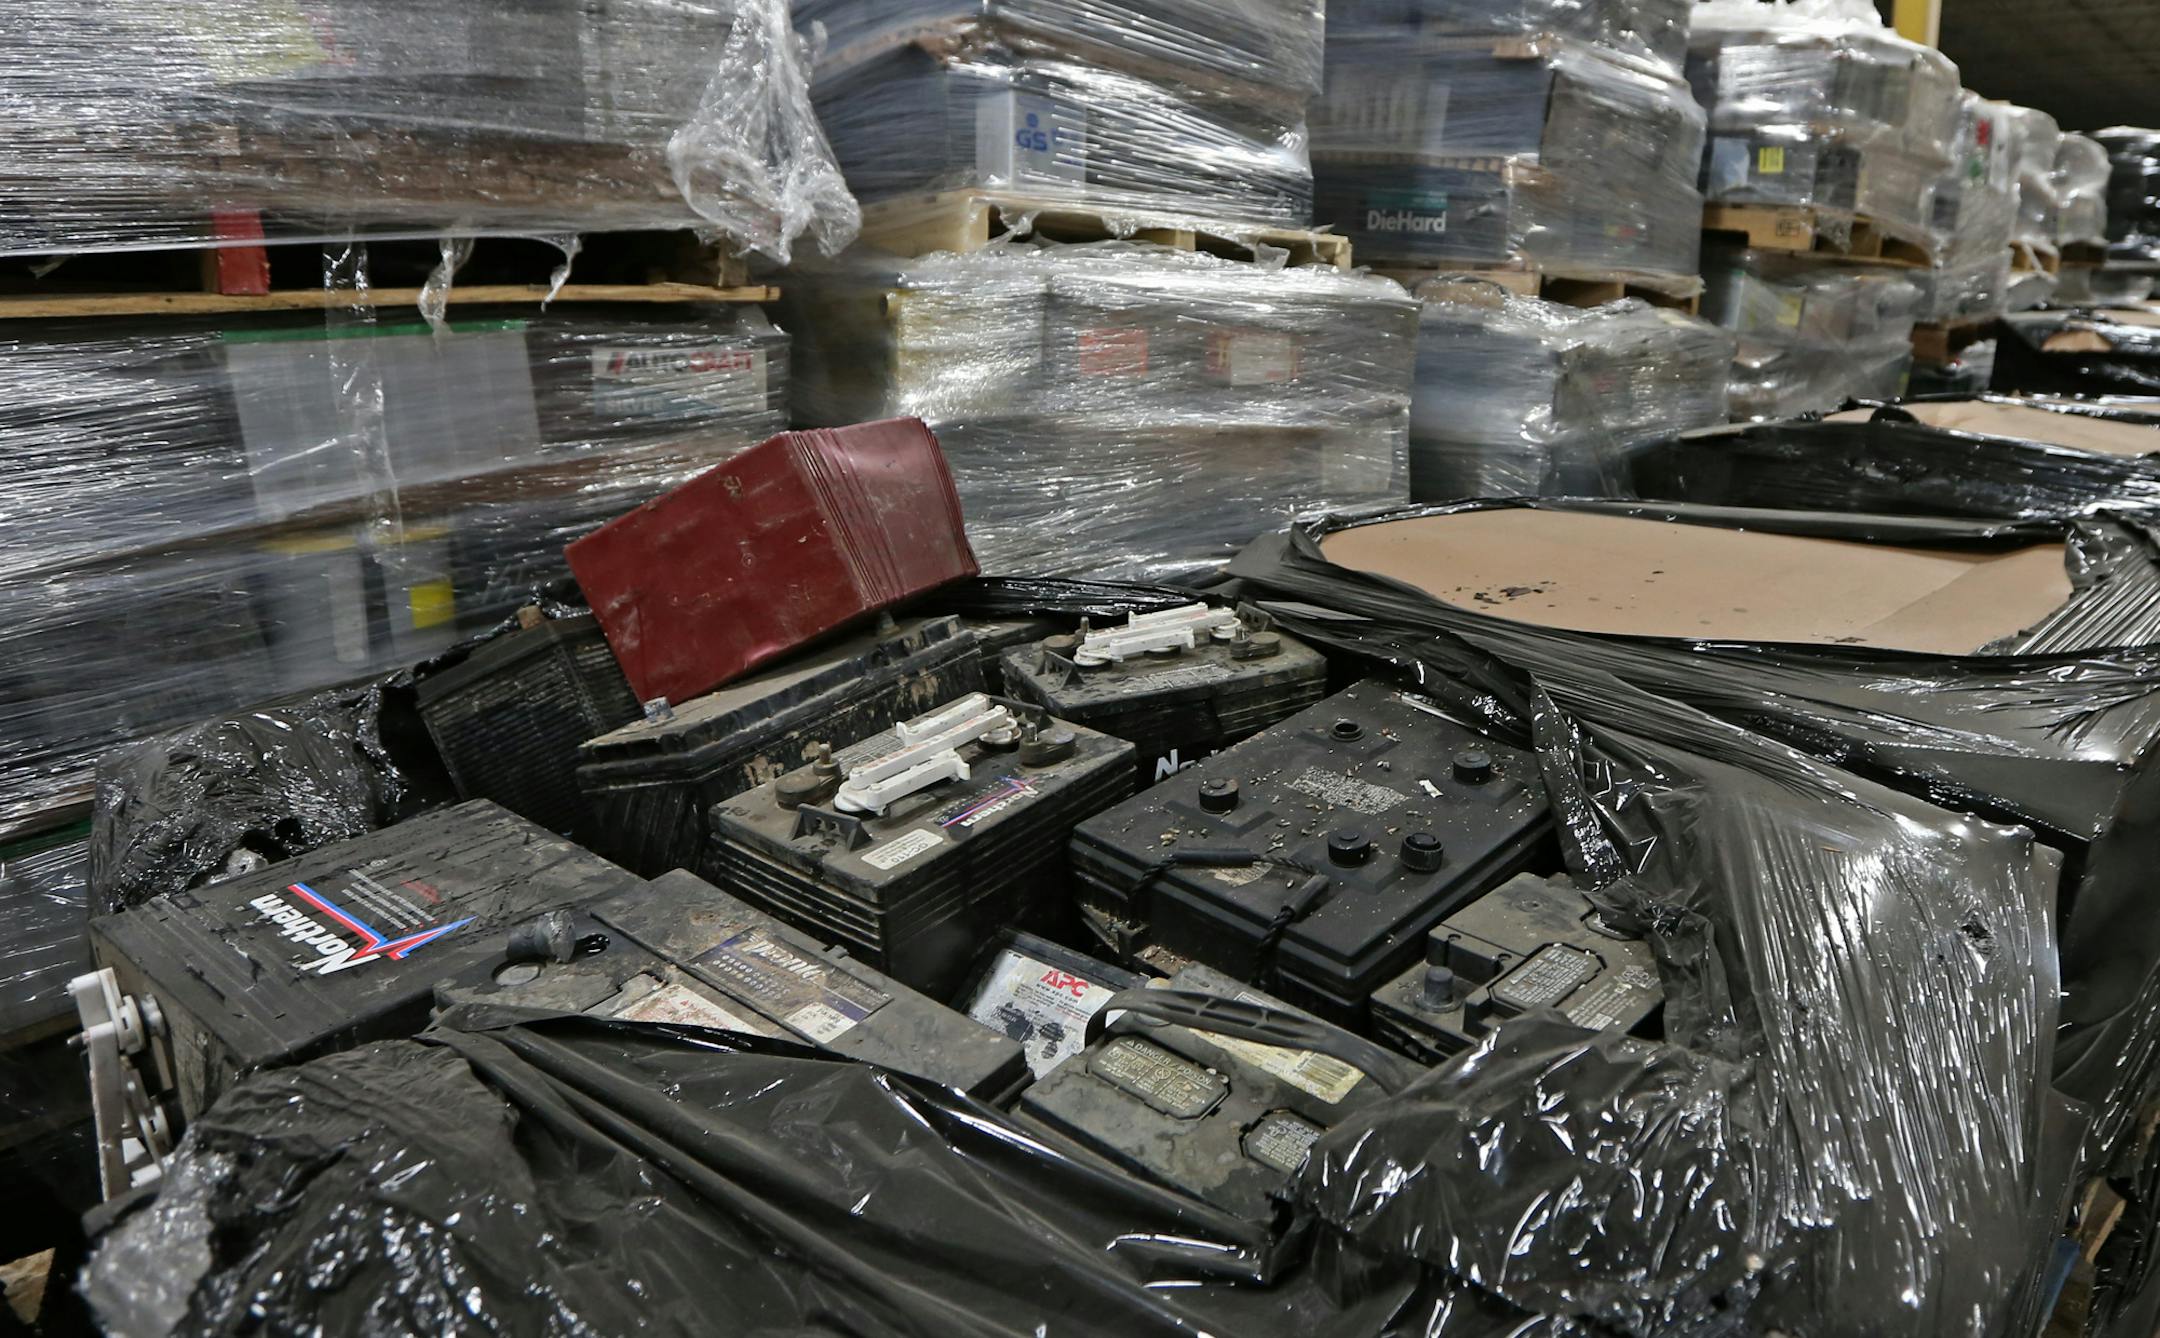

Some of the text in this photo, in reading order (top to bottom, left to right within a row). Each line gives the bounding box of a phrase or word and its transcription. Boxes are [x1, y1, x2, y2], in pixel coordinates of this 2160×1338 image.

[1366, 209, 1447, 232] DieHard
[250, 893, 381, 975] Northern
[1040, 969, 1089, 998] APC
[1133, 1043, 1172, 1065] DANGER
[1177, 1064, 1213, 1084] POISON
